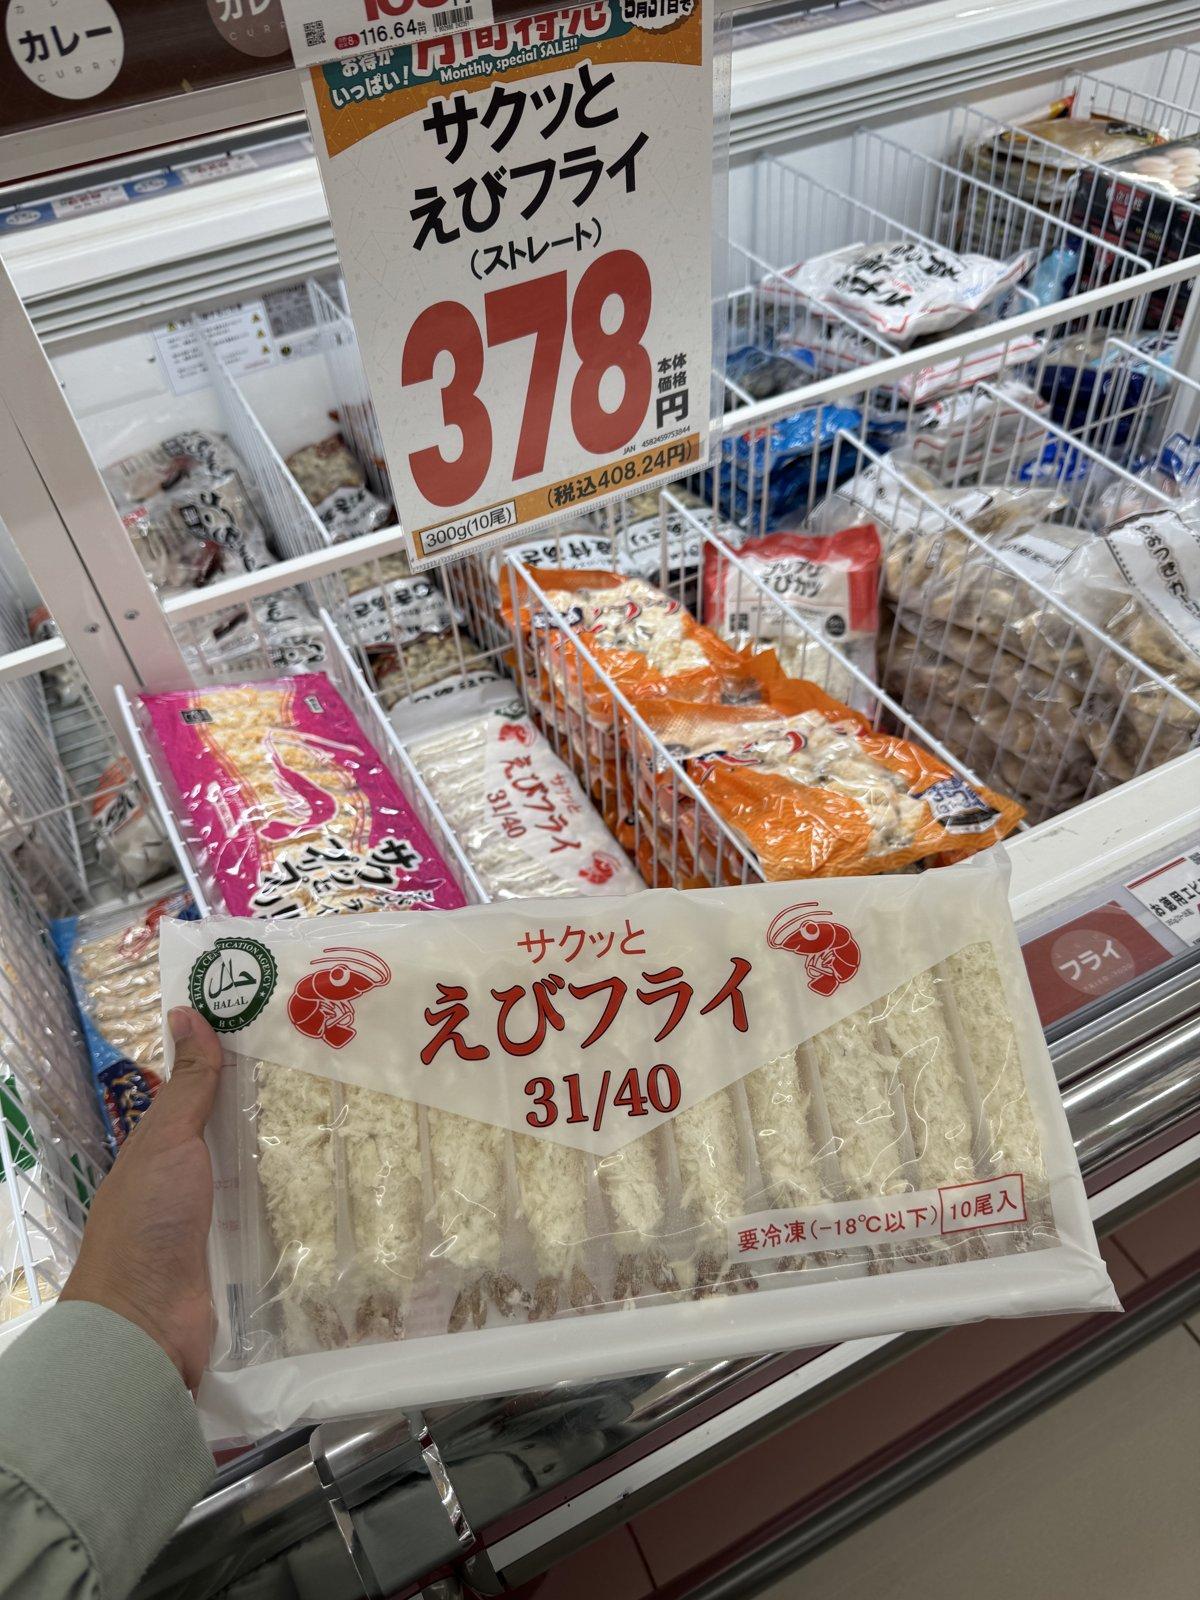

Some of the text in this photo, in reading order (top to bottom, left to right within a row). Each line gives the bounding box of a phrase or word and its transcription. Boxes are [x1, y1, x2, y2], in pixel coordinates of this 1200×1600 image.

[18, 25, 113, 64] カレー
[440, 38, 579, 83] Monthly special SALE!!
[37, 58, 117, 84] CURRY
[331, 65, 409, 107] いっぱい!
[423, 64, 620, 165] サクッと
[409, 131, 650, 251] えびフライ
[470, 217, 603, 280] (ストレート)
[401, 249, 653, 508] 378
[657, 352, 687, 374] 本体
[657, 371, 687, 394] 価格
[656, 388, 689, 430] 円
[623, 445, 636, 456] JAN
[547, 440, 693, 509] (税込408.24円)
[425, 506, 513, 549] 300g(10尾)
[486, 789, 528, 840] 31/40
[500, 752, 583, 856] えびフライ
[553, 772, 581, 813] サクッと
[1149, 878, 1200, 918] お徳用エビ
[517, 919, 647, 965] サクッと
[1059, 939, 1122, 982] フライ
[193, 966, 206, 1001] HALAL
[255, 952, 273, 989] AGENCY
[213, 996, 249, 1011] HALAL
[420, 956, 753, 1066] えびフライ
[523, 1063, 682, 1132] 31/40
[948, 1189, 1019, 1221] 10尾入
[737, 1205, 939, 1253] 要冷凍(-18℃以下)
